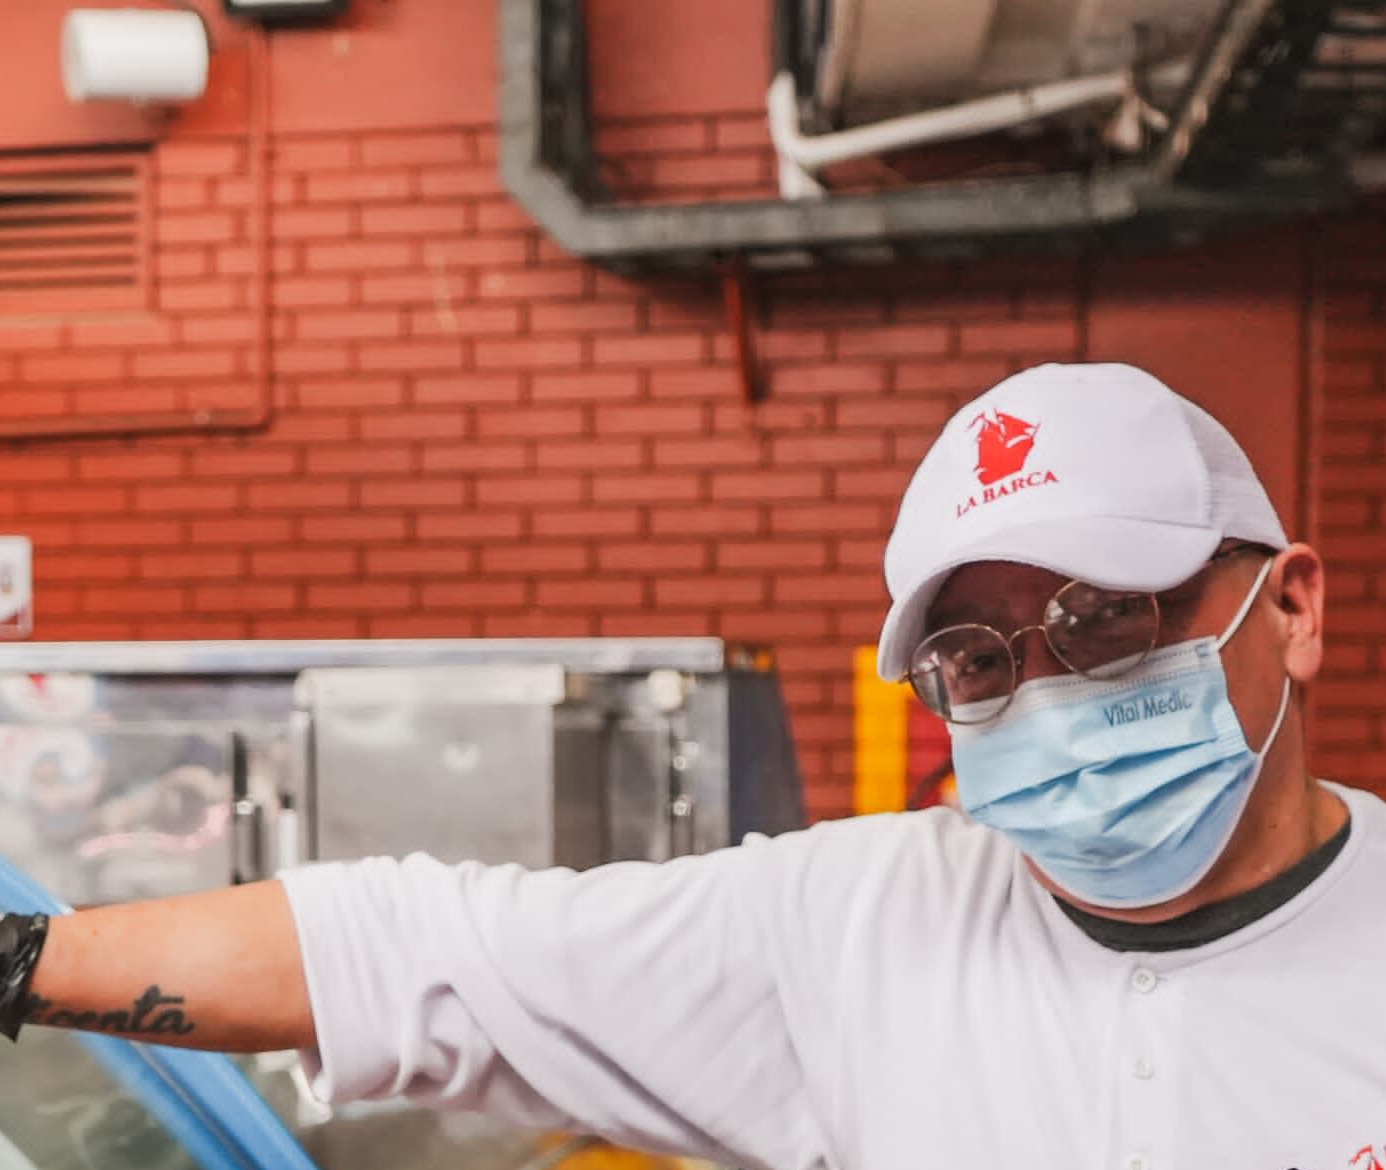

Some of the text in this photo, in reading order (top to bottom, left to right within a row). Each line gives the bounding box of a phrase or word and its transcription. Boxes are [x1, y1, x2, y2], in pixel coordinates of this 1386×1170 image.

[956, 469, 1060, 519] LA BARCA
[1103, 688, 1192, 727] Vital Medic
